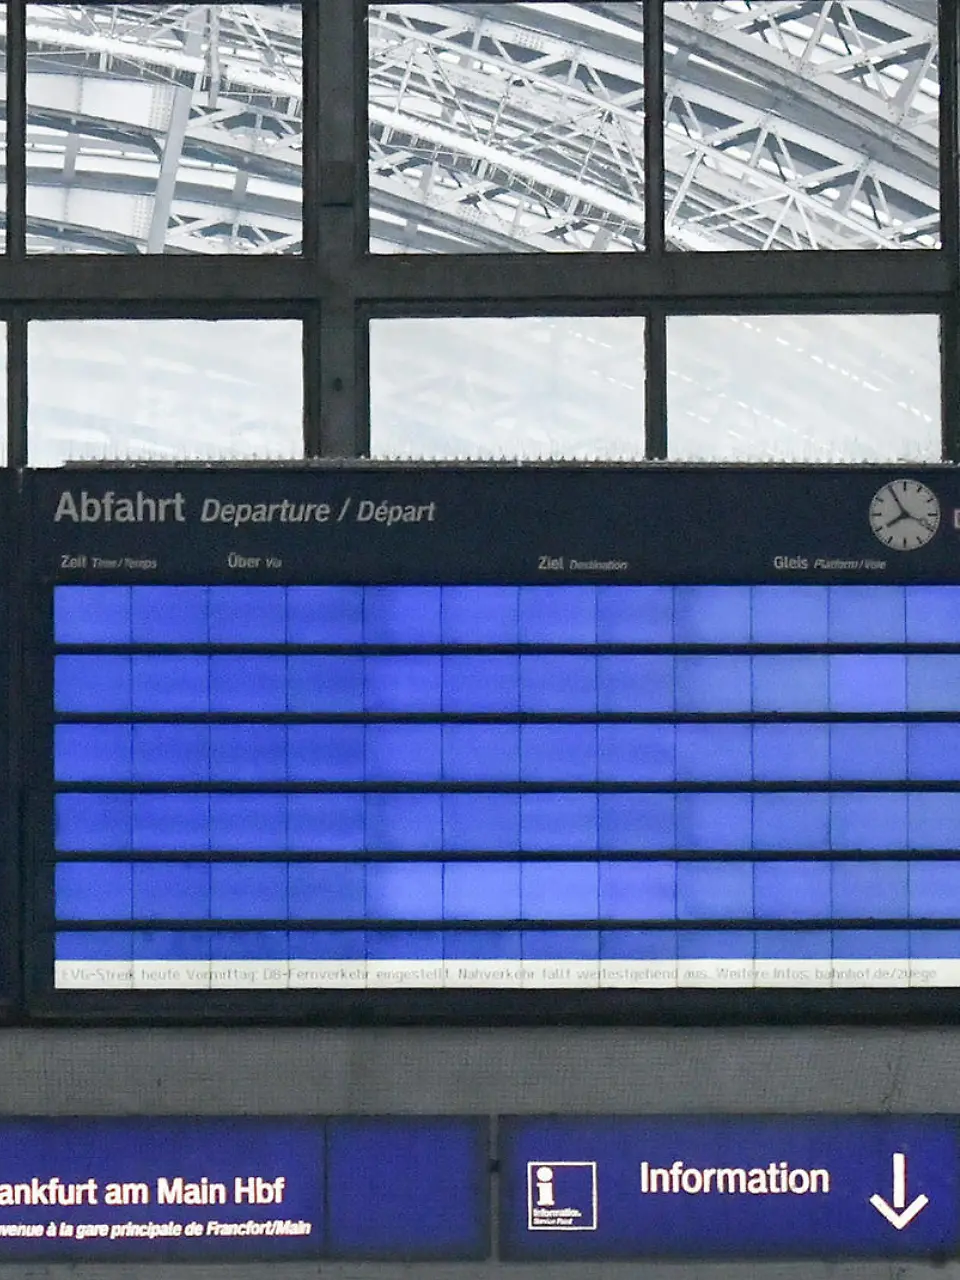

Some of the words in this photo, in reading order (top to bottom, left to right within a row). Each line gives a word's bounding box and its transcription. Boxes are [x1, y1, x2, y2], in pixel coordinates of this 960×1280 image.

[54, 491, 186, 523] Abfahrt
[200, 498, 331, 528] Departure
[356, 499, 436, 527] Départ
[60, 554, 87, 569] Zeit
[227, 551, 261, 569] Über
[537, 555, 565, 571] Ziel
[773, 555, 809, 570] Gleis
[640, 1160, 830, 1194] Information
[104, 1182, 149, 1205] am
[157, 1176, 227, 1205] Main
[234, 1176, 285, 1204] Hbf
[46, 1220, 57, 1237] à
[59, 1221, 74, 1237] la
[75, 1224, 109, 1239] gare
[110, 1221, 182, 1239] principale
[184, 1220, 204, 1236] de
[206, 1220, 312, 1236] Francfort/Main
